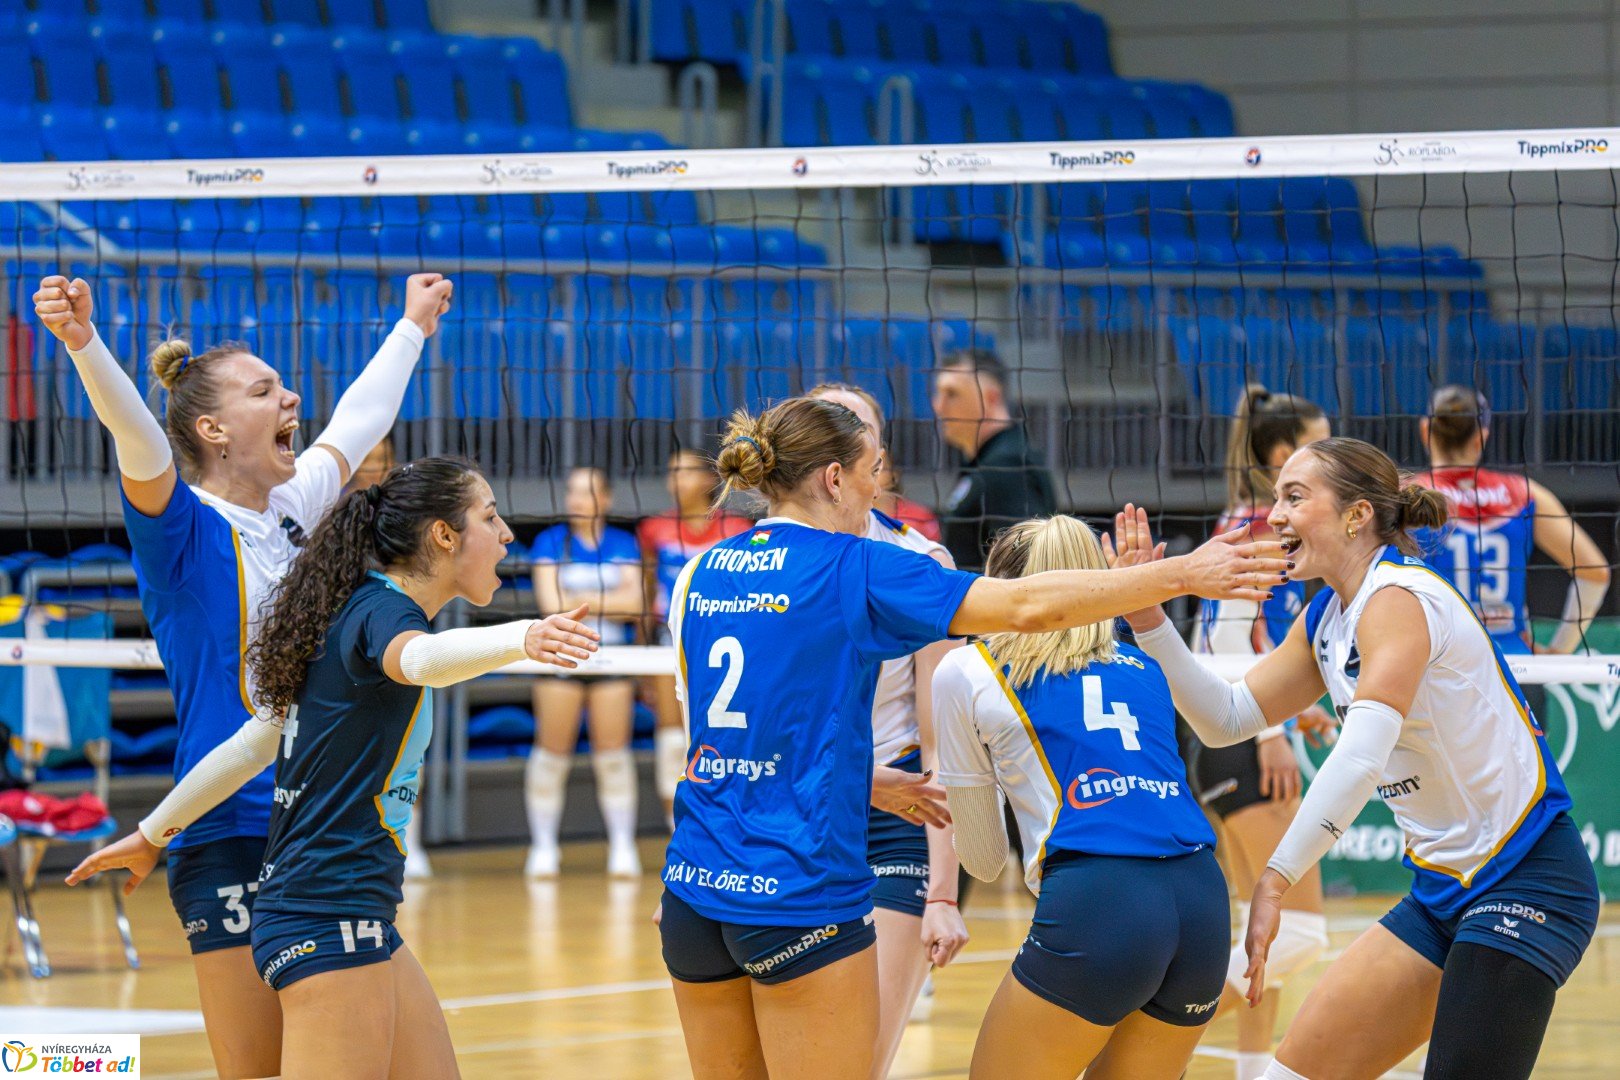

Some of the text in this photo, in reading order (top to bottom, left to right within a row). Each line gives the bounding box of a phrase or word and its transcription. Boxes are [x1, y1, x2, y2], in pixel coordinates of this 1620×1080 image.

[1049, 151, 1135, 169] TippmixPRO
[1517, 139, 1608, 157] TippmixPRO
[187, 169, 264, 184] TippmixPRO
[607, 161, 688, 178] TippmixPRO
[1446, 532, 1510, 603] 13
[688, 592, 790, 618] TippmixPRO
[707, 636, 748, 729] 2
[1082, 675, 1141, 751] 4
[1077, 773, 1180, 799] ingrasys
[664, 861, 697, 884] MÁV
[697, 867, 749, 893] ELŐRE
[751, 875, 779, 895] SC
[339, 920, 384, 953] 14
[1493, 924, 1520, 939] erima
